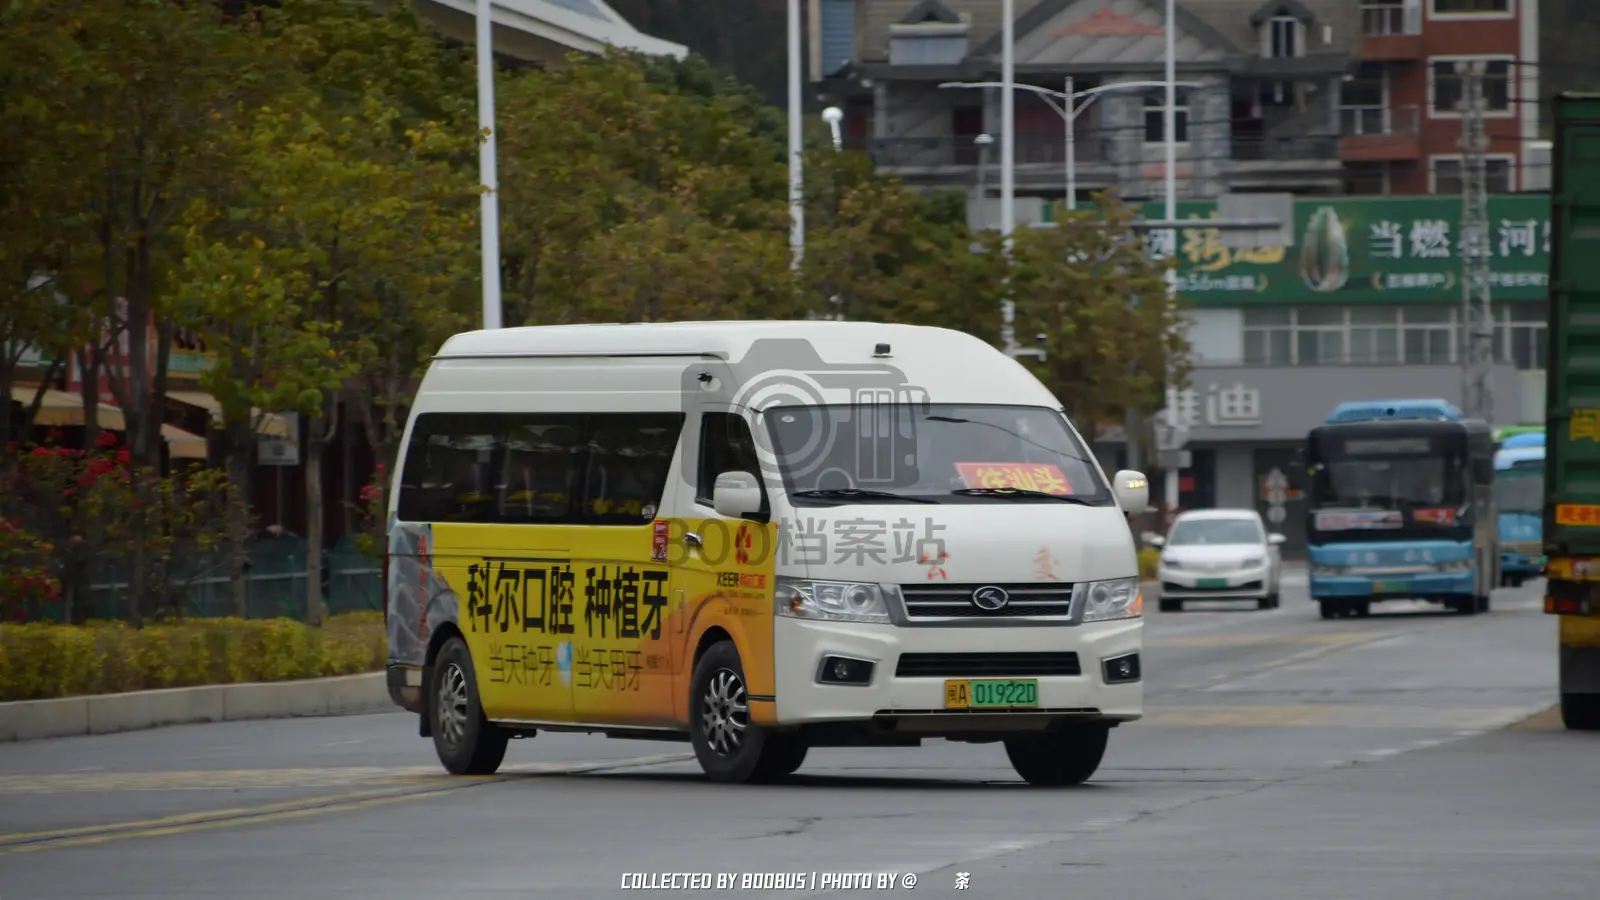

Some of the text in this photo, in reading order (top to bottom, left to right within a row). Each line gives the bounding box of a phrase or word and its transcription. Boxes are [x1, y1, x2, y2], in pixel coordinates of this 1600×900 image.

[467, 561, 575, 634] 科尔口腔
[585, 565, 669, 641] 种植牙
[489, 641, 644, 692] 当天种牙 当天用牙
[975, 682, 1037, 704] 01922D
